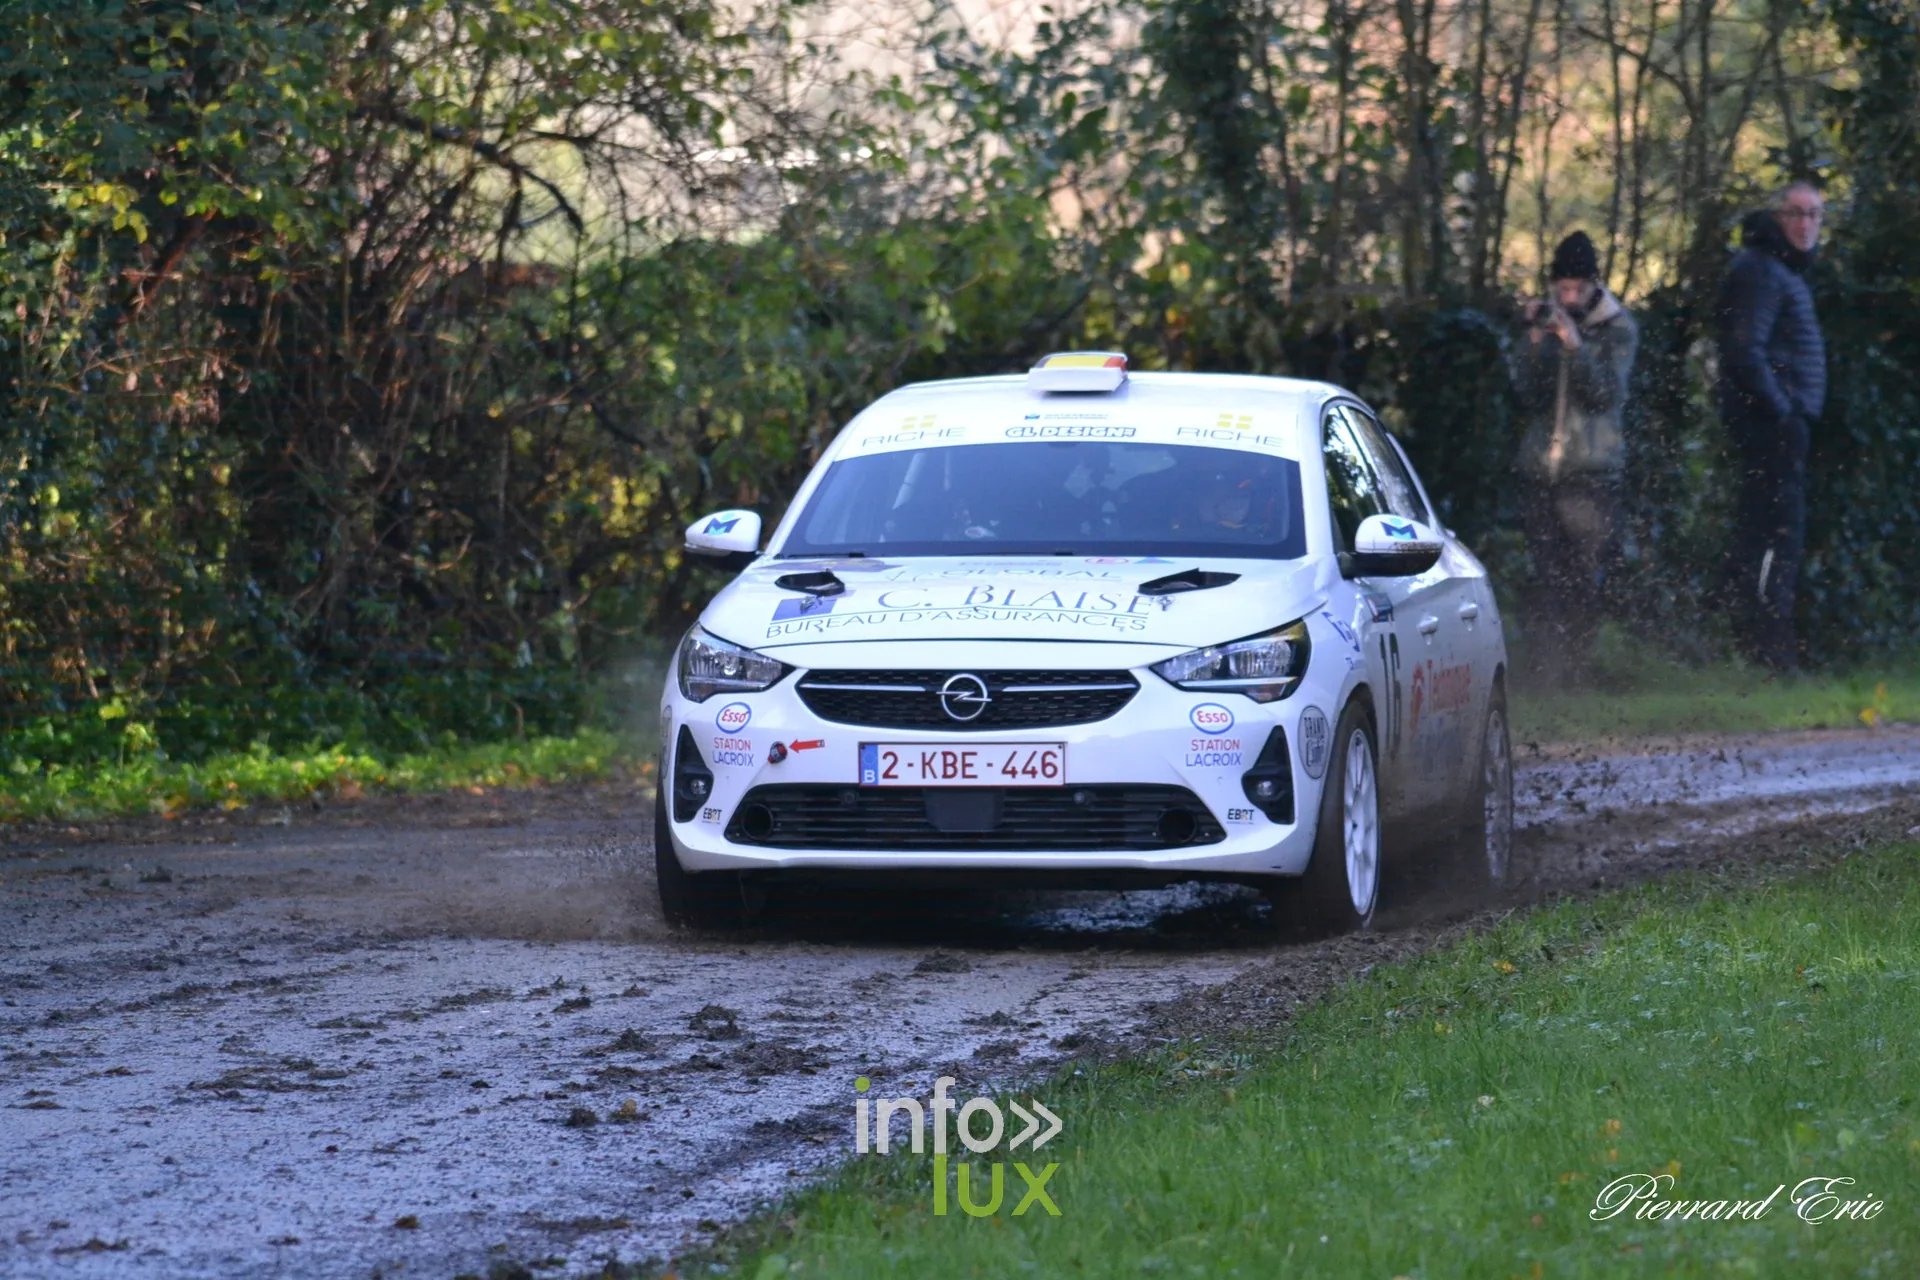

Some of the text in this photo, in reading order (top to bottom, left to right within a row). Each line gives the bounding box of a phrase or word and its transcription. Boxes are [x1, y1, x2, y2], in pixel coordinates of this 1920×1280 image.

[862, 427, 965, 447] RICHE
[1177, 427, 1284, 448] RICHE
[964, 584, 1149, 615] BLAISE
[766, 608, 1147, 639] BUREAU D'ASSURANCES
[714, 737, 751, 751] STATION
[1191, 739, 1241, 751] STATION
[712, 751, 754, 767] LACROIX
[1186, 753, 1242, 767] LACROIX
[863, 769, 876, 783] B
